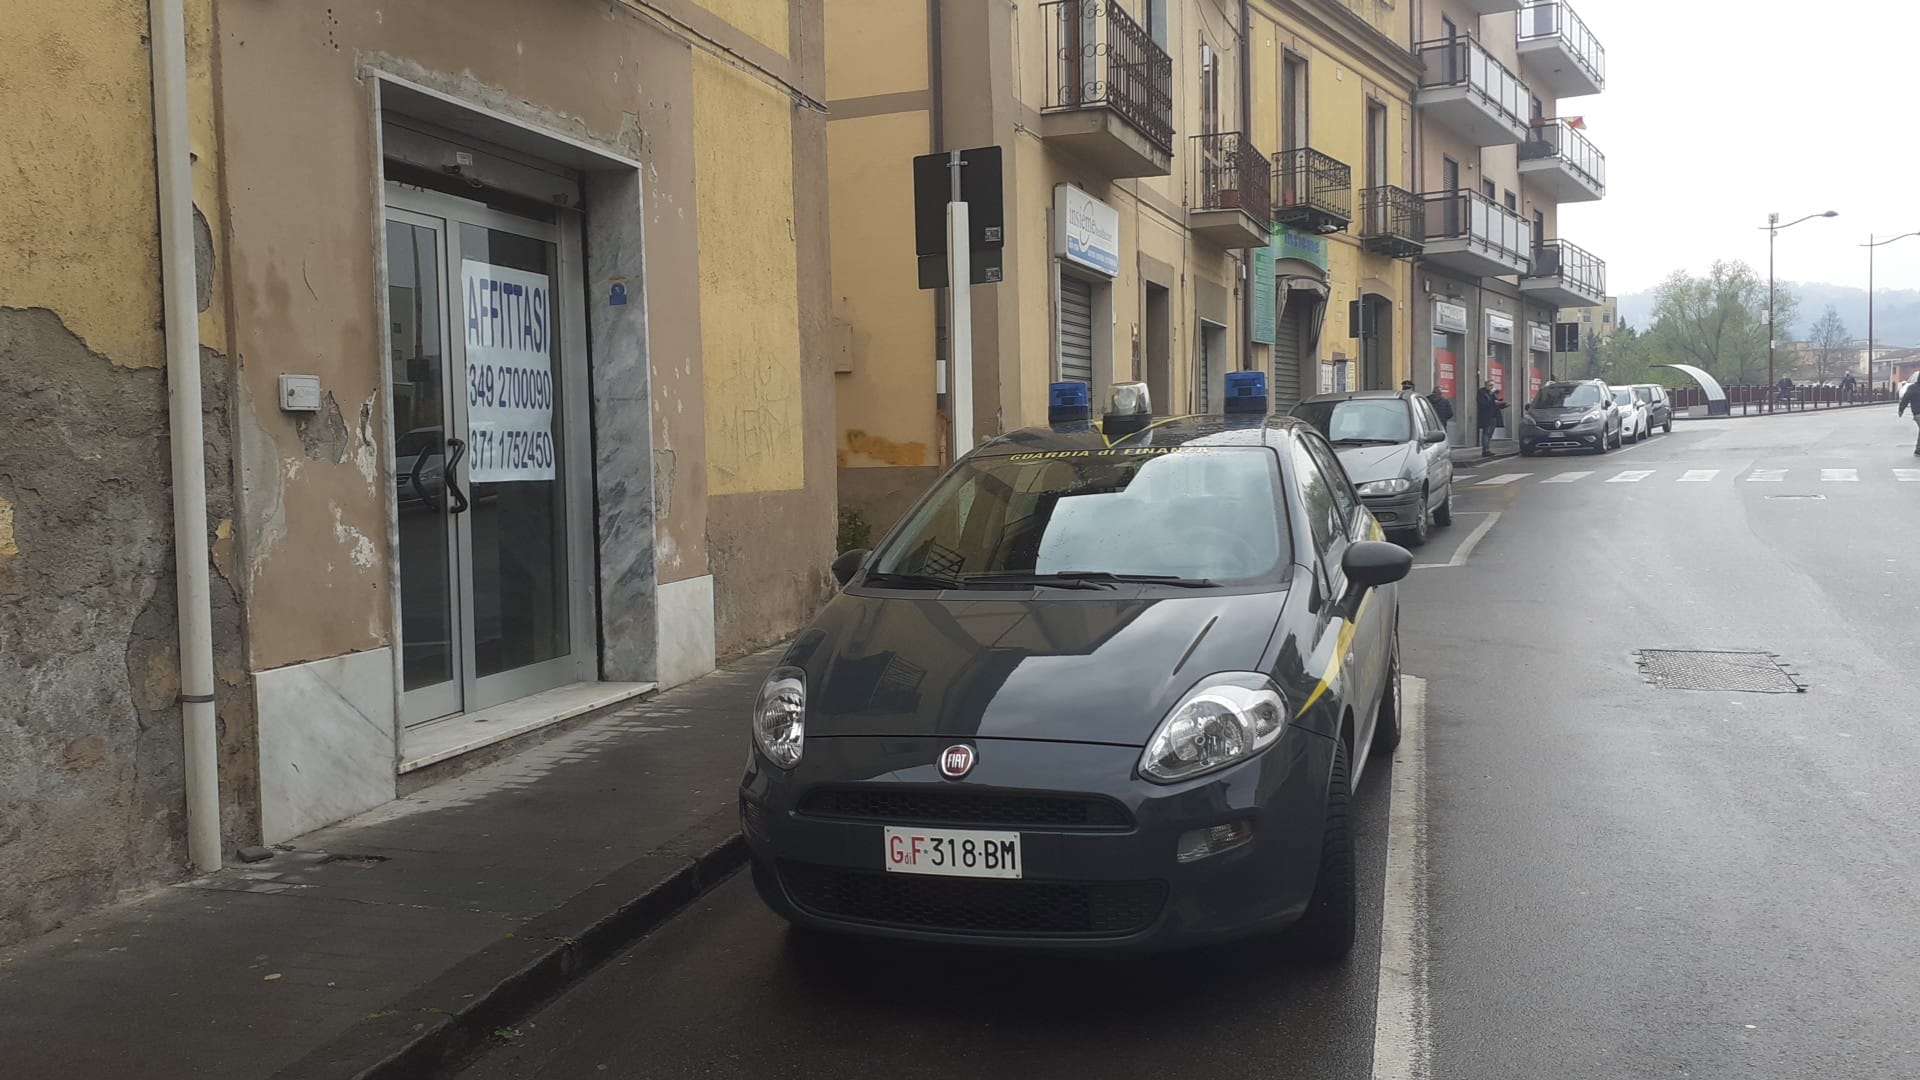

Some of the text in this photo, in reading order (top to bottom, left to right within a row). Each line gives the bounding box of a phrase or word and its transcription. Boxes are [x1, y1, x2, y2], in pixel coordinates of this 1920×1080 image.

[468, 276, 547, 353] AFFITTASI
[469, 363, 551, 410] 349 2700090
[471, 430, 552, 471] 371 1752450
[1010, 446, 1209, 460] GUARDIA di FINANZA
[947, 753, 967, 768] FIAT
